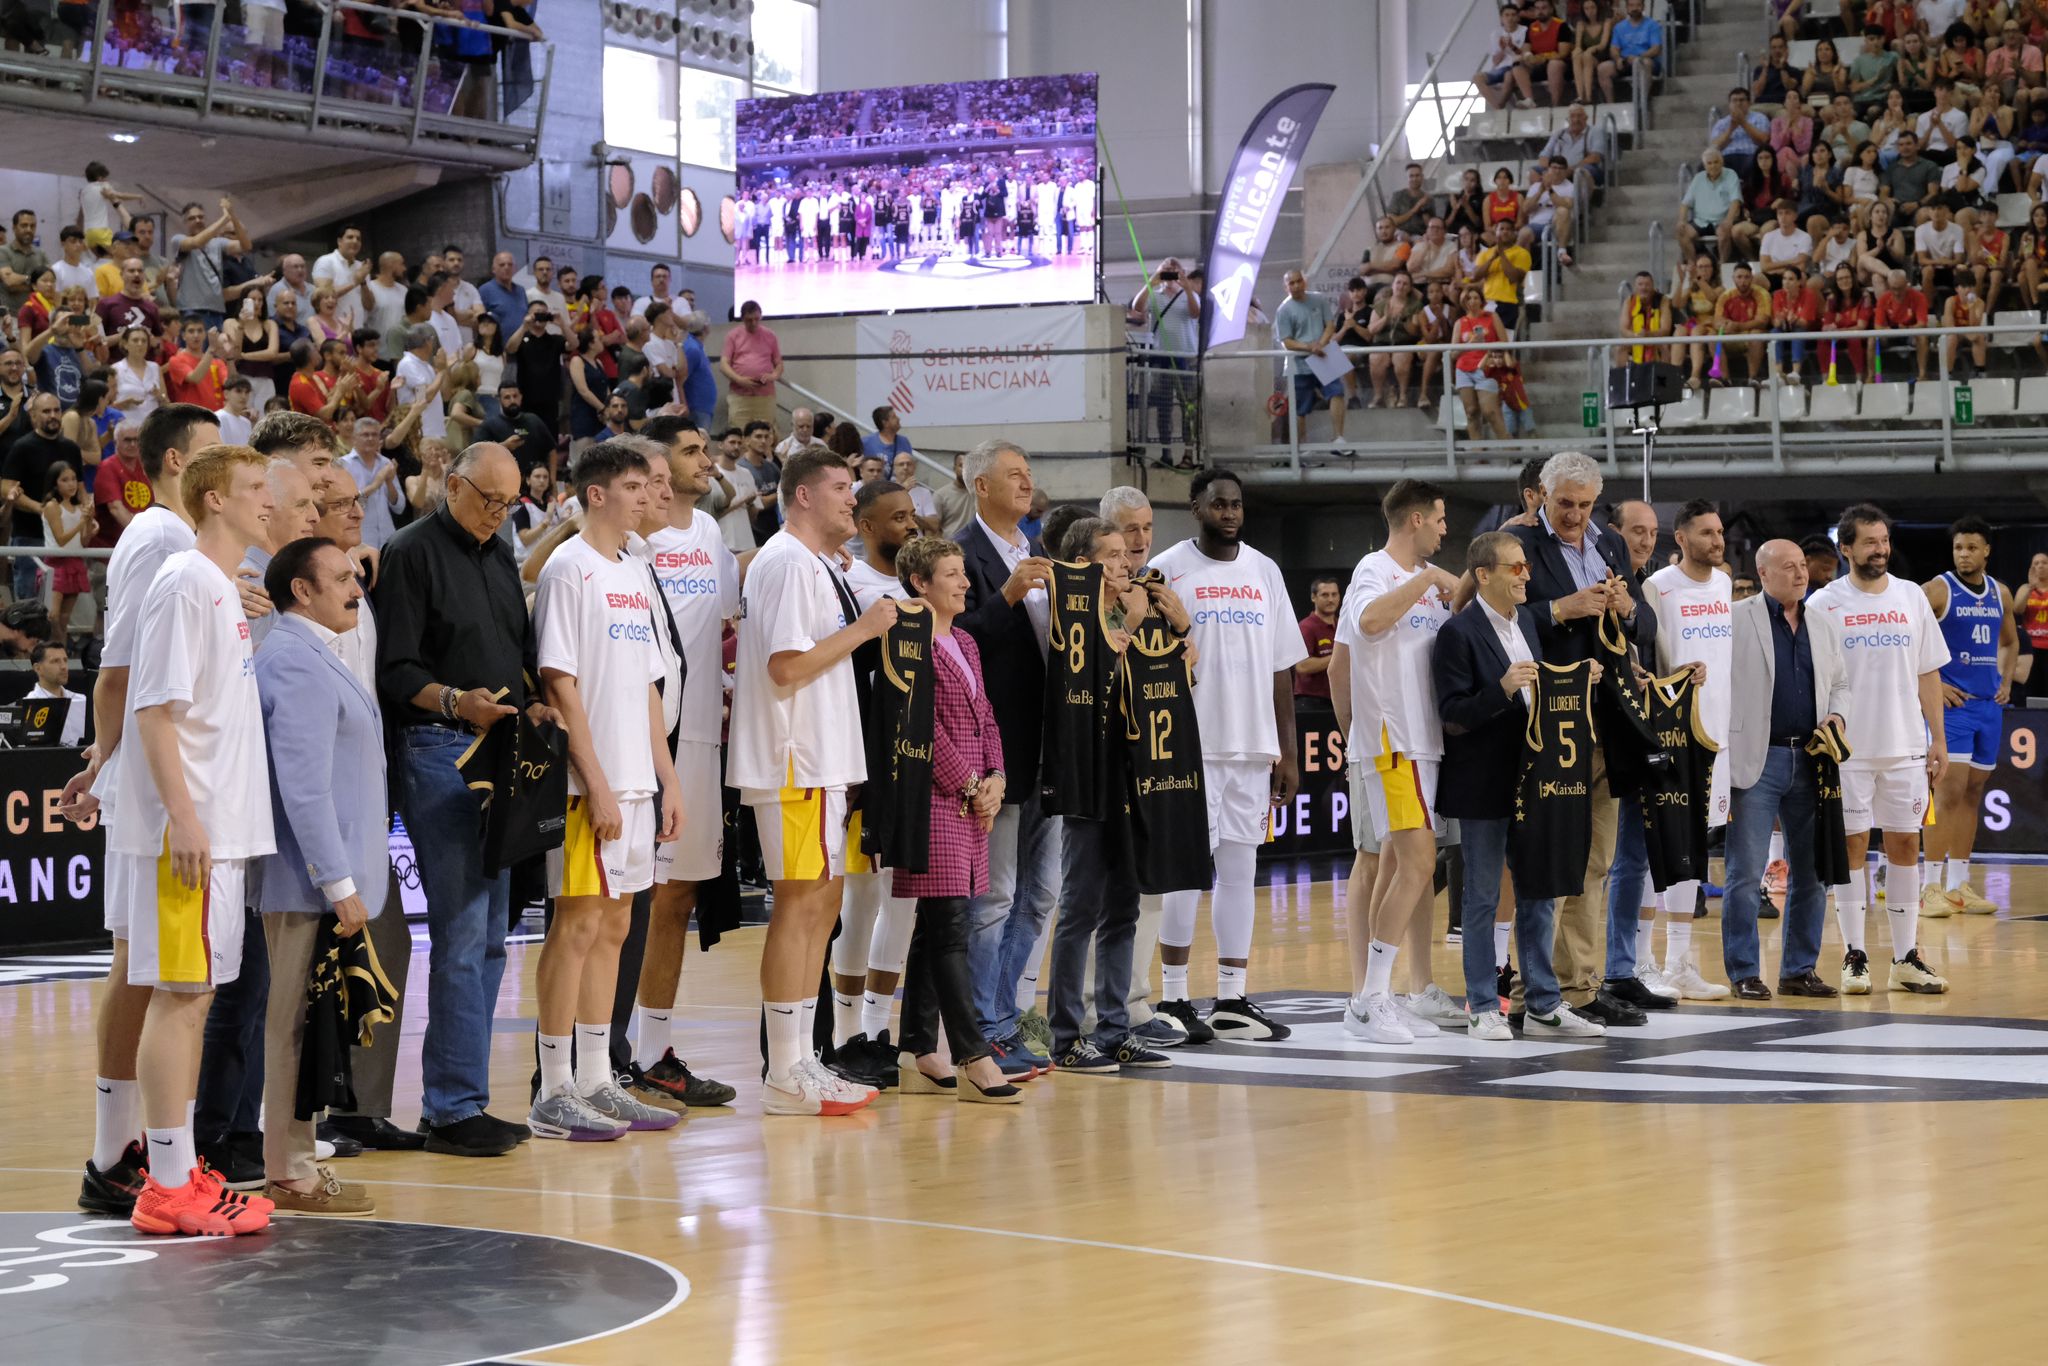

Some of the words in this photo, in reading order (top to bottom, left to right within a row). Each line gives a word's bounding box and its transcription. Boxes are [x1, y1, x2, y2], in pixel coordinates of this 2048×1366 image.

[1229, 116, 1296, 255] Alicante
[1218, 175, 1247, 246] DEPORTES
[922, 343, 1054, 367] GENERALITAT
[923, 369, 1052, 392] VALENCIANA
[655, 548, 713, 568] ESPAÑA
[605, 592, 650, 611] ESPAÑA
[1195, 585, 1263, 601] ESPAÑA
[1195, 606, 1265, 626] endesa
[1680, 601, 1730, 617] ESPAÑA
[1844, 610, 1909, 626] ESPAÑA
[1956, 606, 2001, 618] DOMINICANA
[1844, 632, 1911, 649] endesa
[1971, 624, 1991, 644] 40
[1069, 622, 1085, 674] 8
[904, 670, 916, 725] 7
[1549, 695, 1581, 712] LLORENTE
[1149, 708, 1173, 761] 12
[1558, 721, 1577, 768] 5
[2010, 727, 2036, 769] 9
[1984, 789, 2012, 832] S
